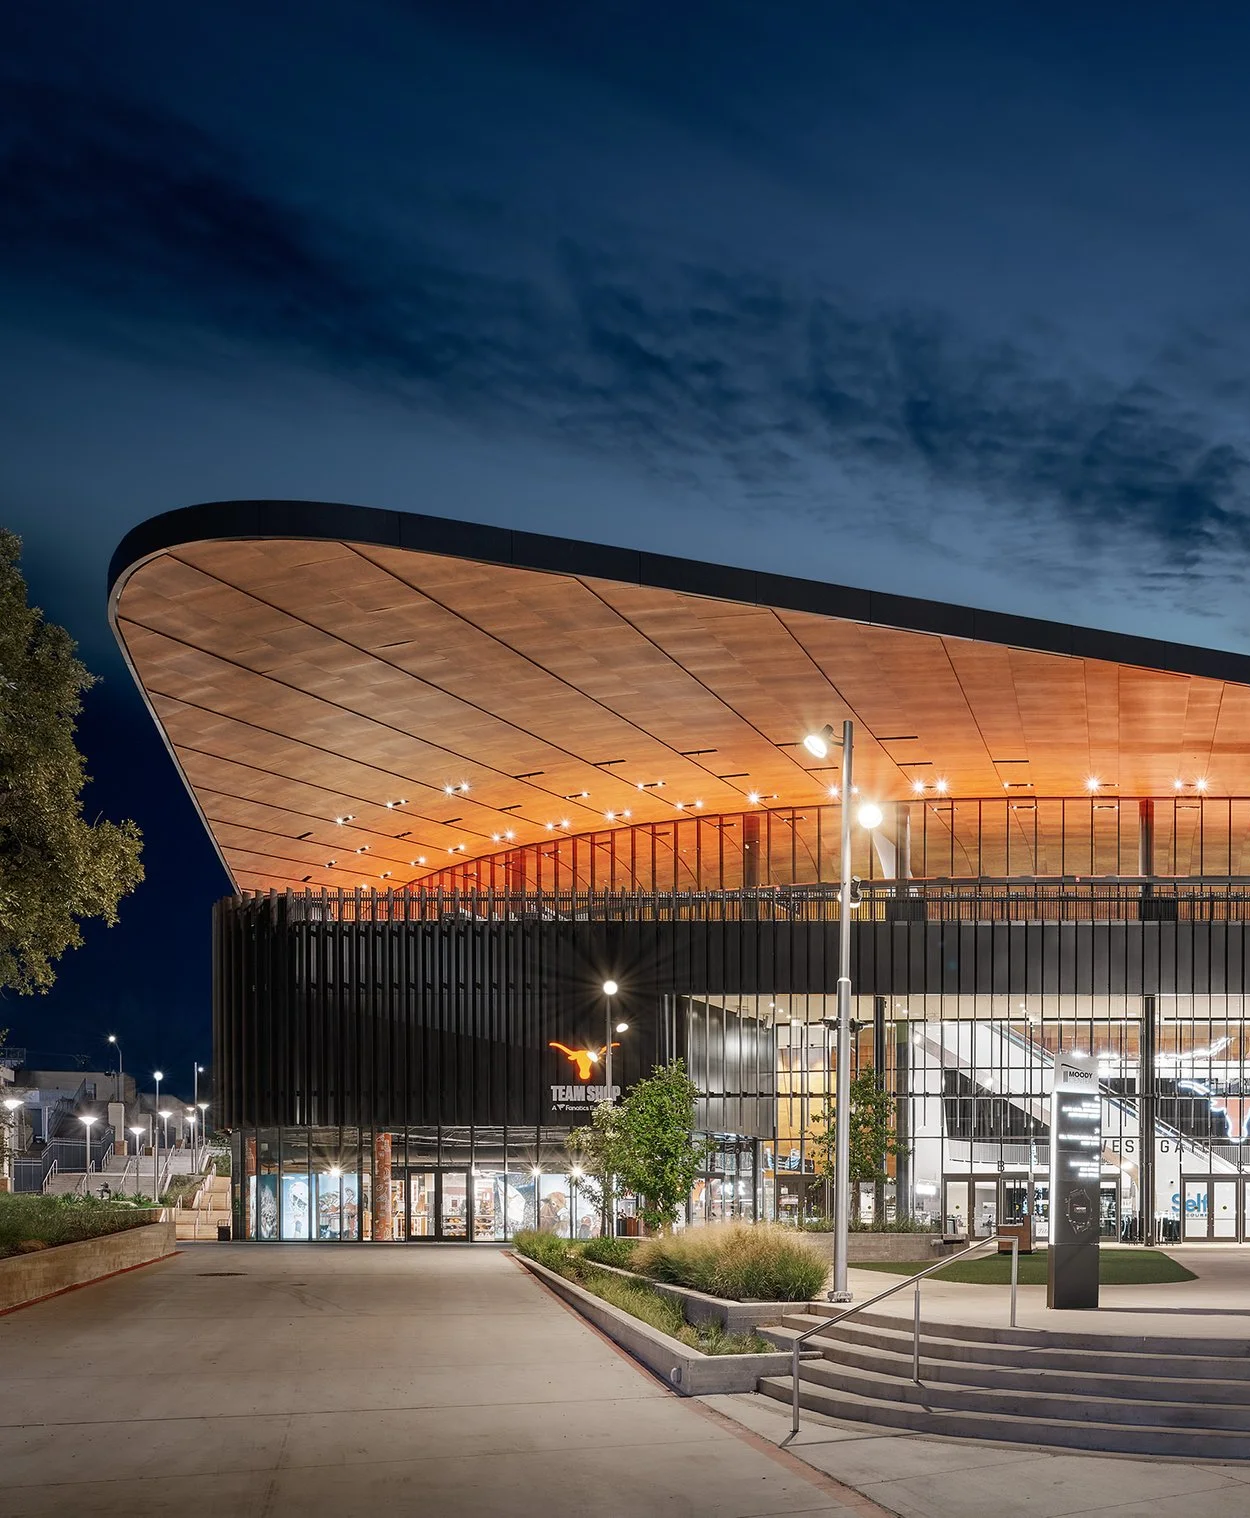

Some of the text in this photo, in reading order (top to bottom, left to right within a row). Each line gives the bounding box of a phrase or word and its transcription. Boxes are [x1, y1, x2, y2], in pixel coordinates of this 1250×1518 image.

[1068, 1071, 1093, 1079] MOODY
[550, 1085, 586, 1102] TEAM
[998, 1160, 1005, 1171] B
[1171, 1192, 1208, 1213] Self
